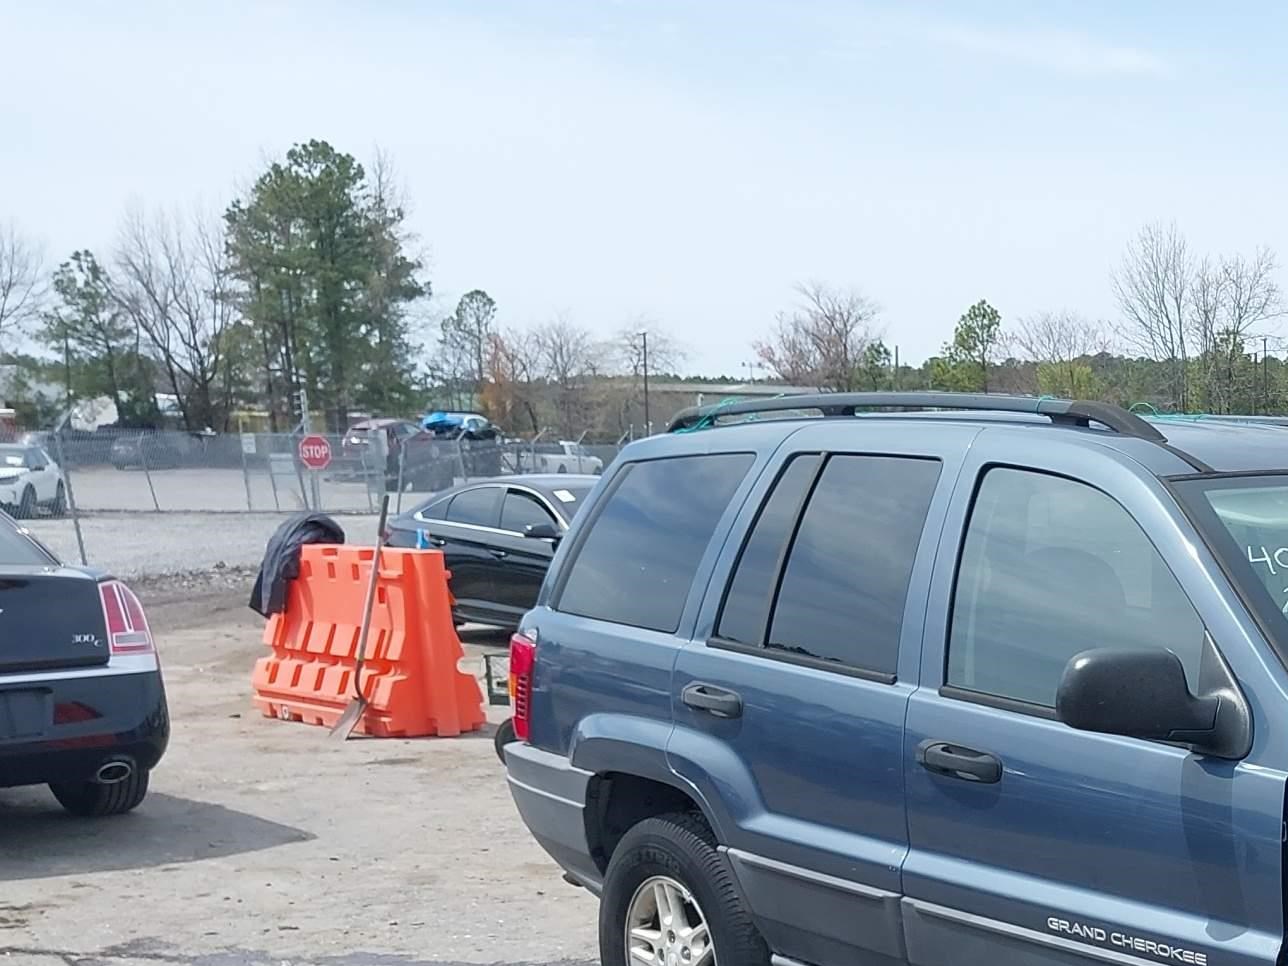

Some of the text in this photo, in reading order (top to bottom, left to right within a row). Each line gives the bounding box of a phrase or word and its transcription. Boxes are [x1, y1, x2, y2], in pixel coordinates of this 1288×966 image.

[302, 445, 329, 459] STOP
[1047, 917, 1207, 966] GRAND CHEROKEE
